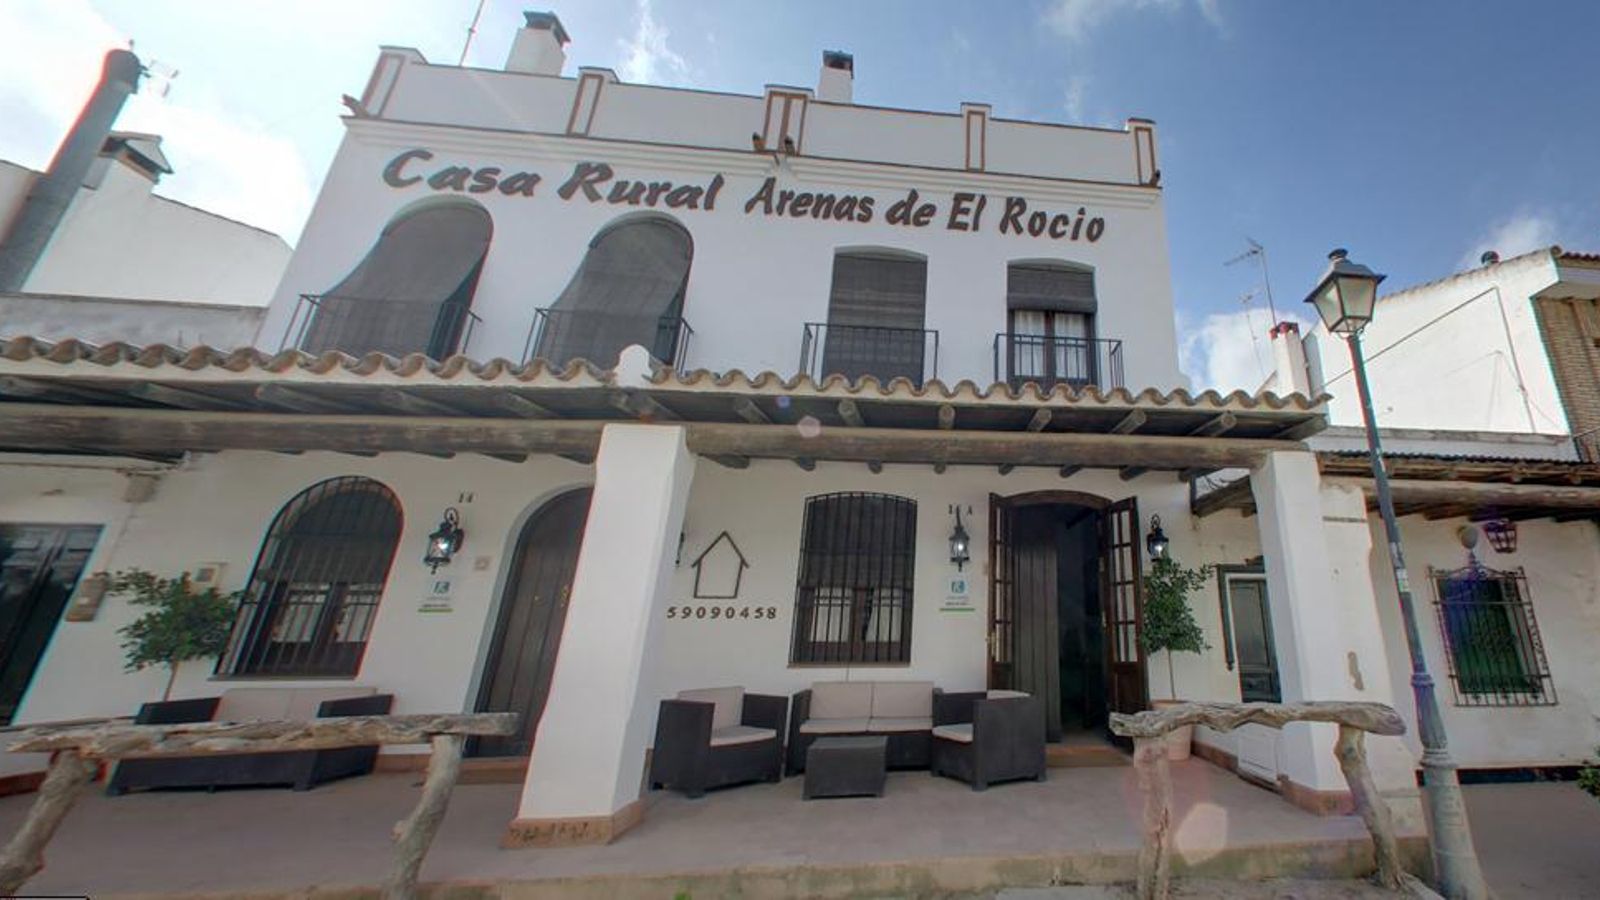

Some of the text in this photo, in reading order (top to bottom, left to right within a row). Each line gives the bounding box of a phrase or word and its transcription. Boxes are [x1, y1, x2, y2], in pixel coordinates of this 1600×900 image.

[382, 150, 1105, 243] Casa Rural Arenas de El Rocio
[667, 606, 777, 619] 59090458
